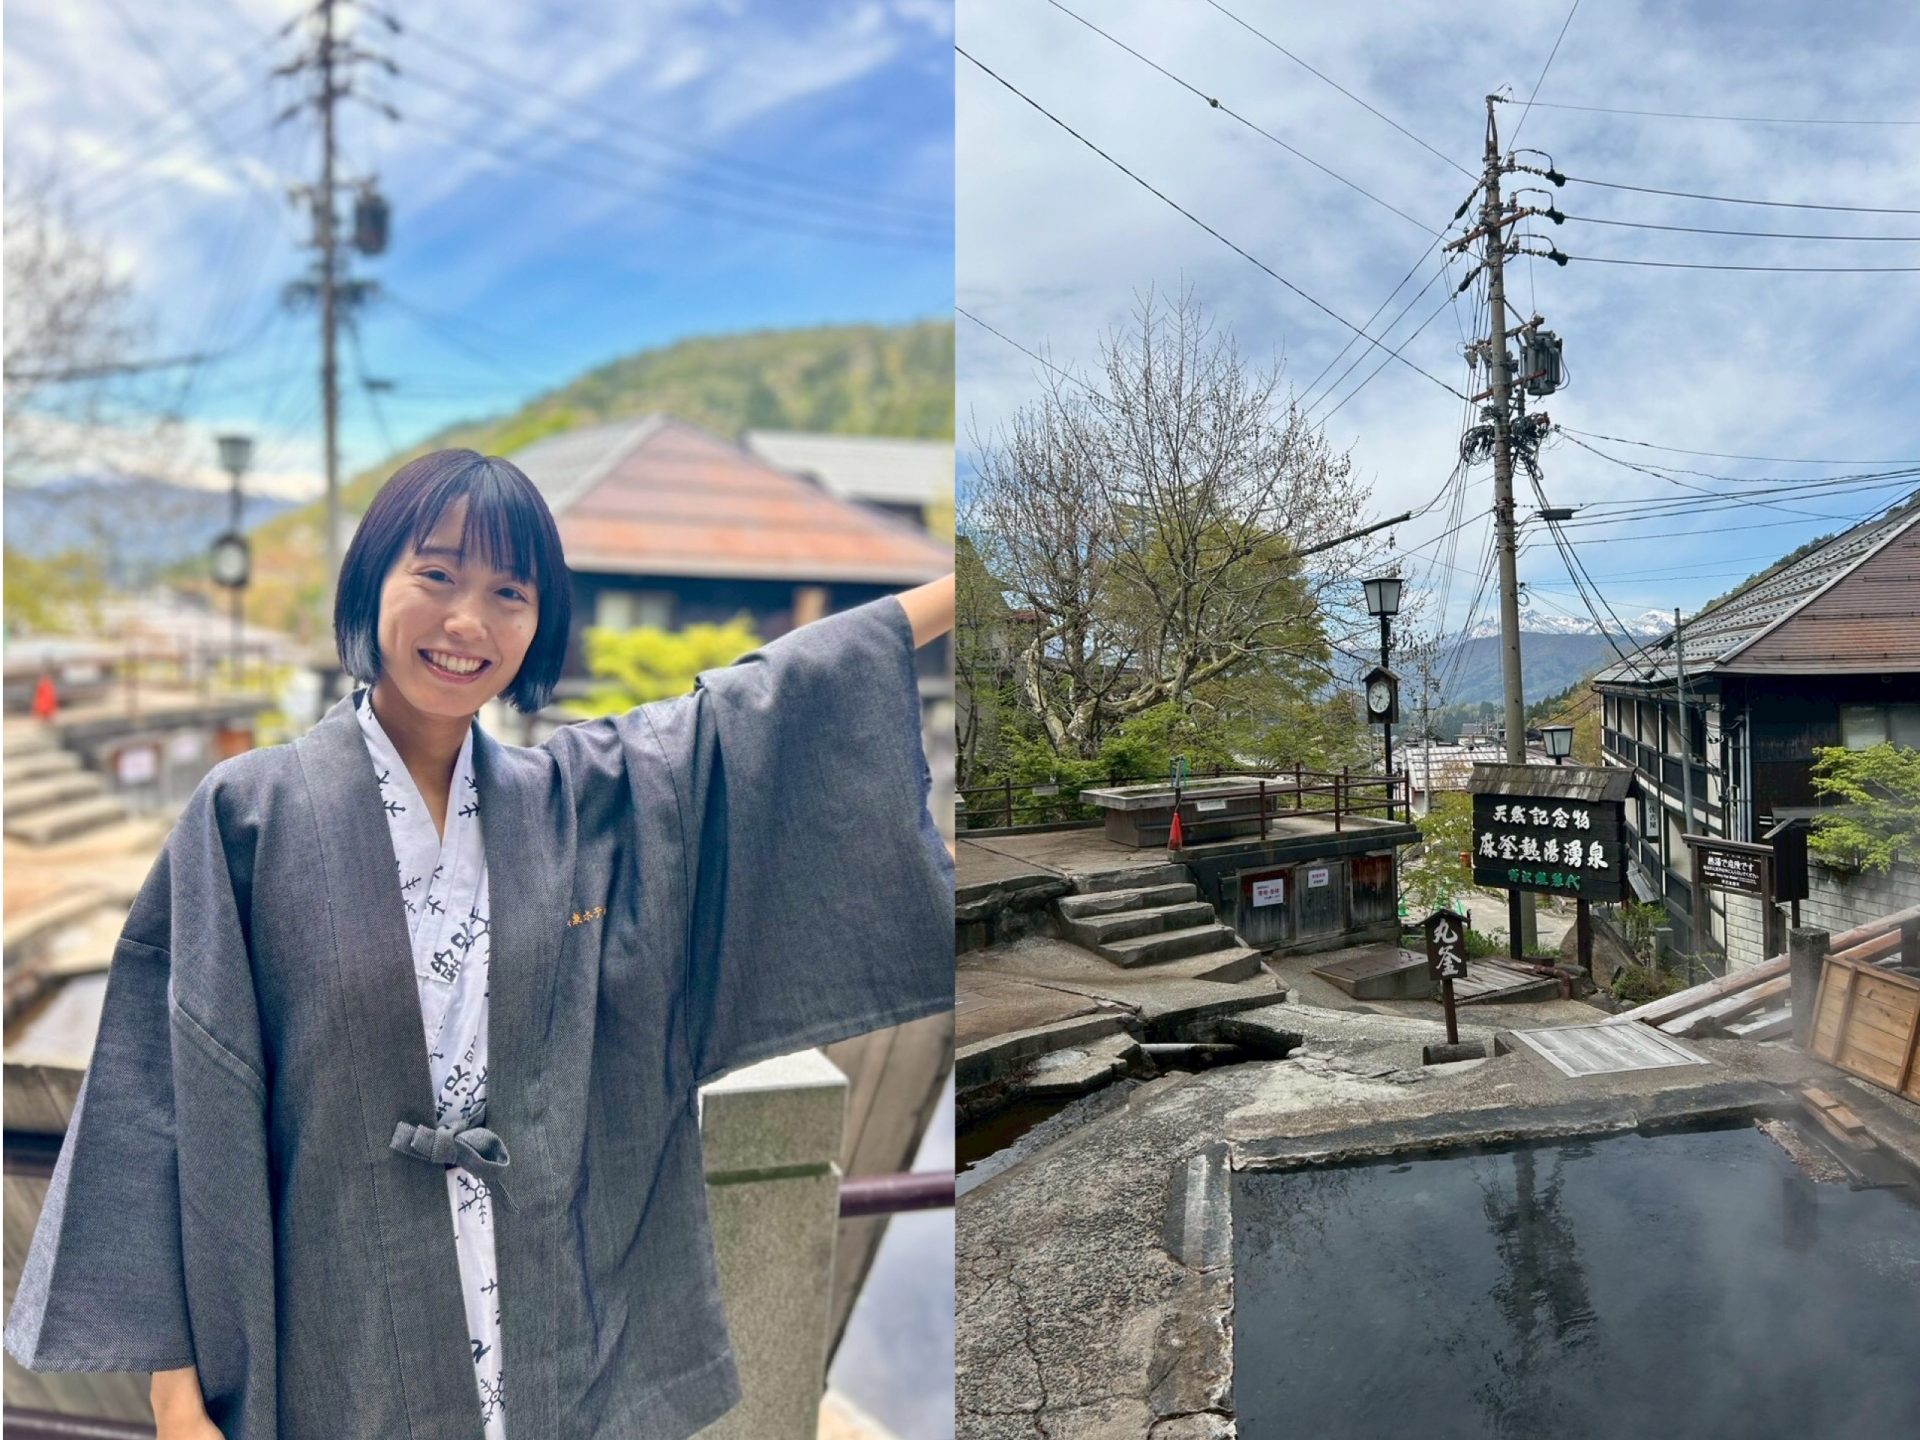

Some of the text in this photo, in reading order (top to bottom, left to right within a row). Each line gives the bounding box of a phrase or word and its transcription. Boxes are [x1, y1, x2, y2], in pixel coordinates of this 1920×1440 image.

[1492, 805, 1591, 830] 天然記念物
[1479, 832, 1608, 869] 麻釜熱湯湧泉
[1433, 919, 1462, 976] 丸釜
